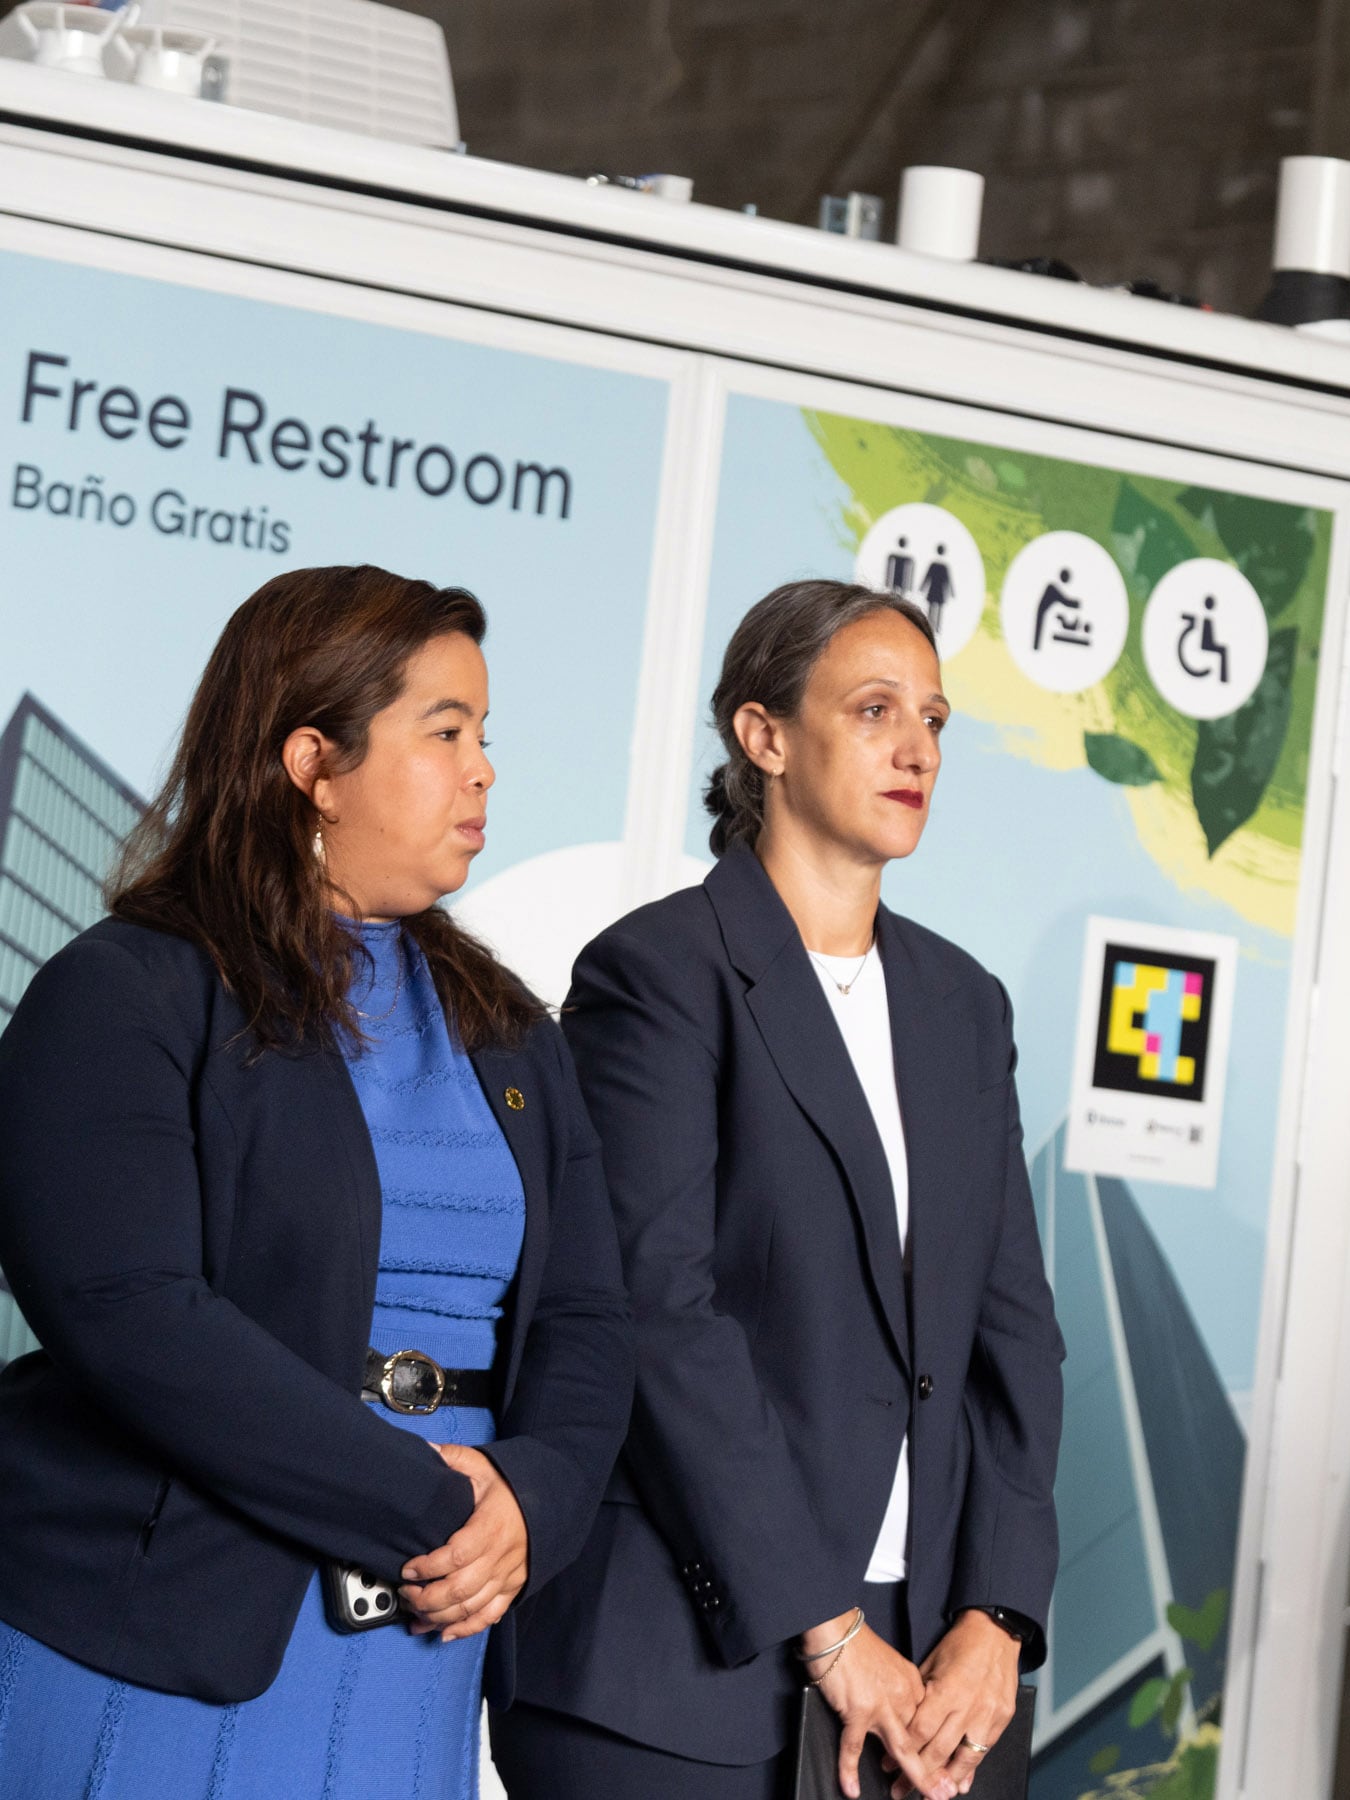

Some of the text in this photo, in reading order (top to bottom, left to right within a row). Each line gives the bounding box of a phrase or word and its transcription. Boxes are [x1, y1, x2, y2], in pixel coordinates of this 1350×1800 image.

[20, 351, 573, 520] Free Restroom
[11, 463, 291, 554] Baño Gratis
